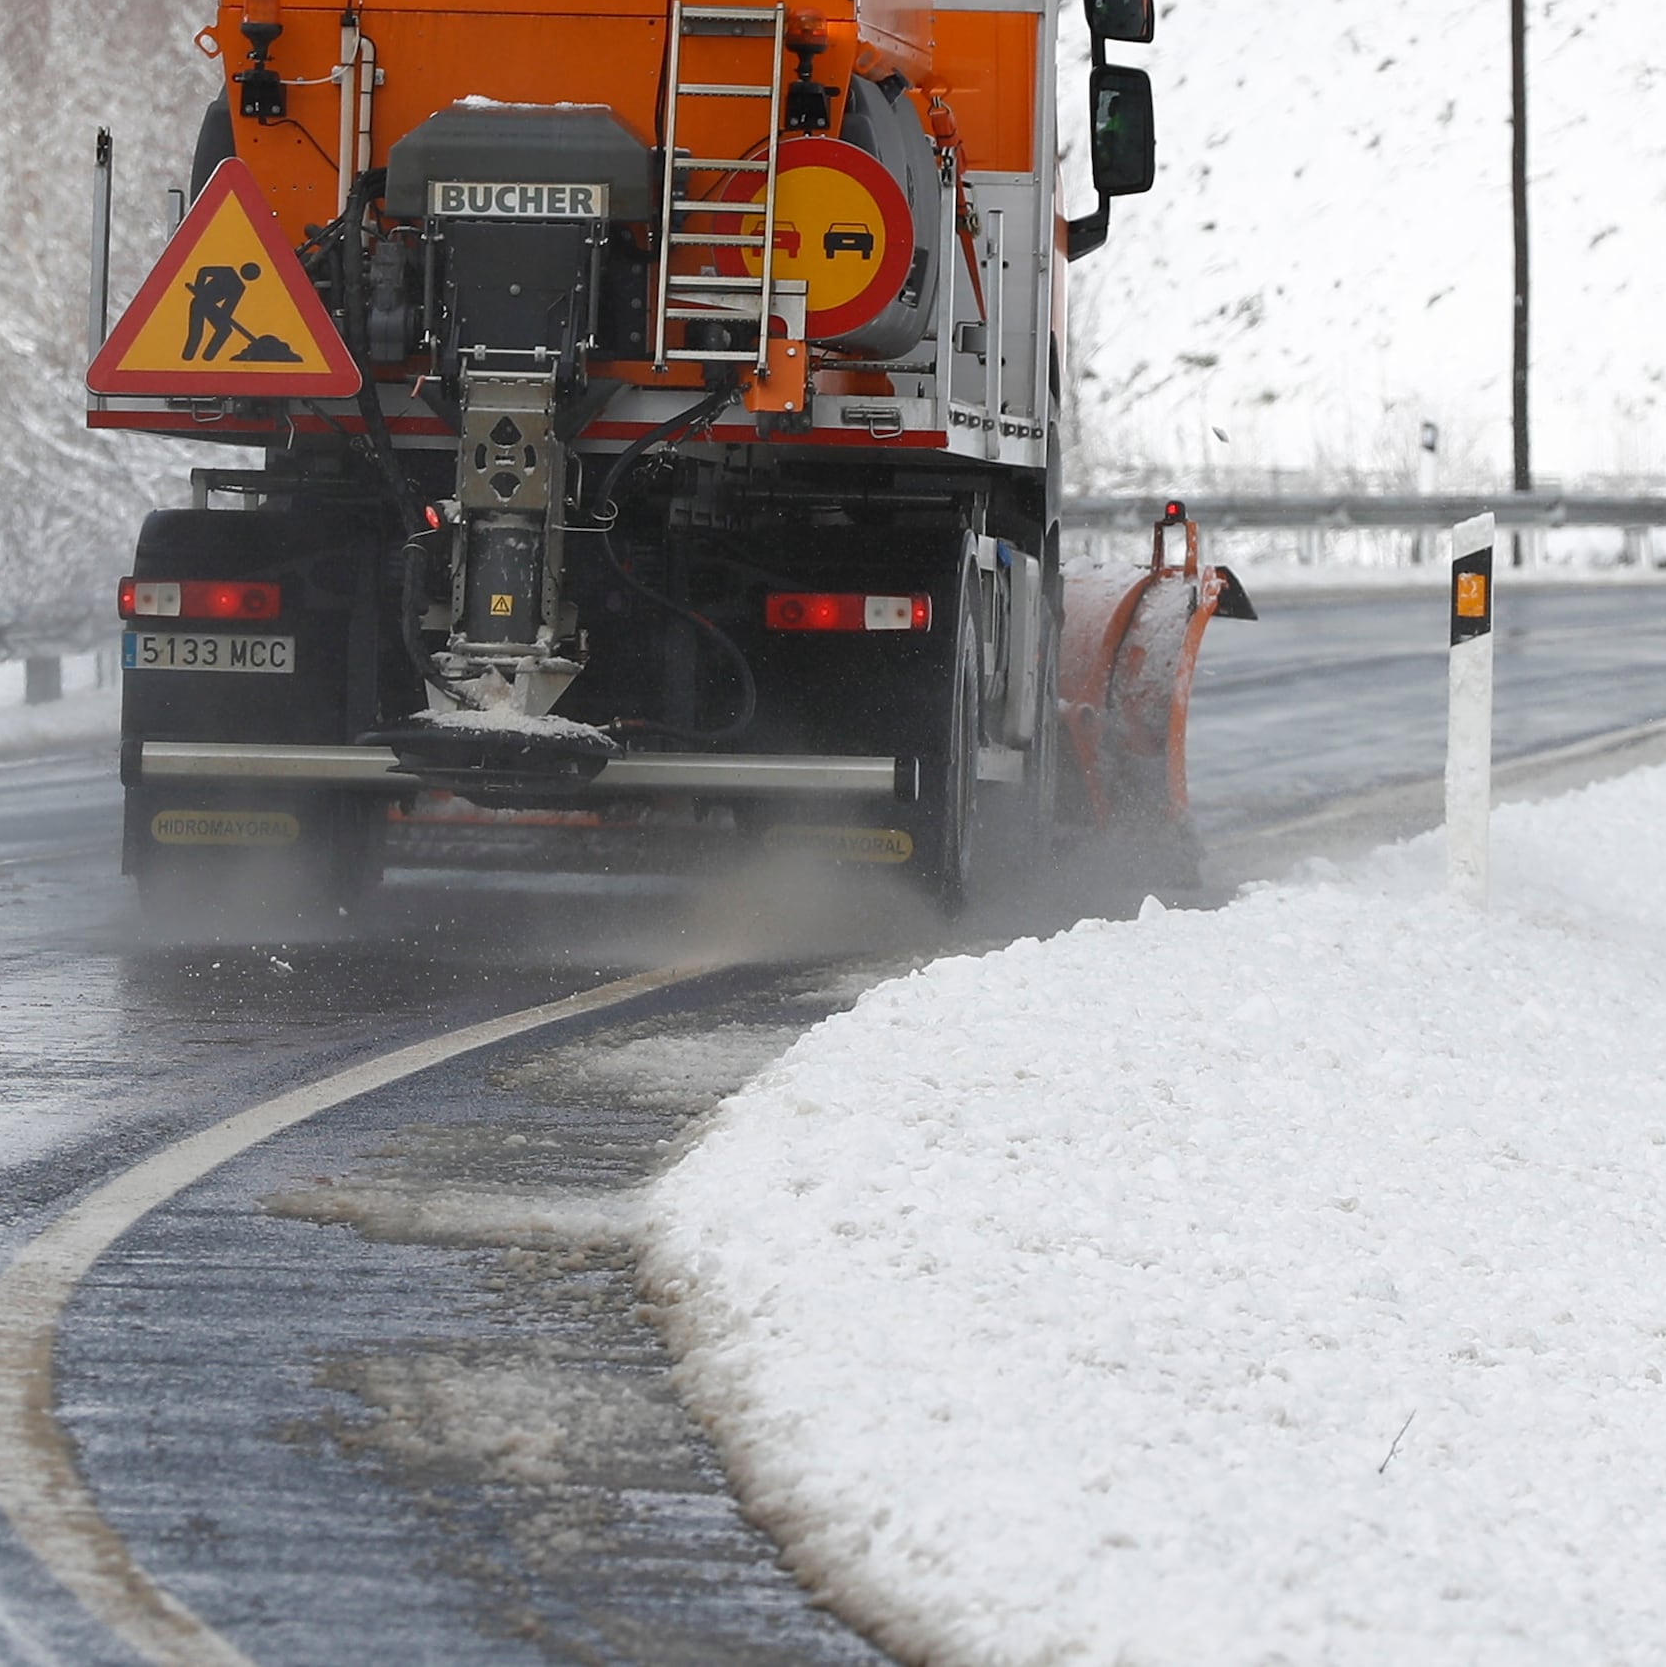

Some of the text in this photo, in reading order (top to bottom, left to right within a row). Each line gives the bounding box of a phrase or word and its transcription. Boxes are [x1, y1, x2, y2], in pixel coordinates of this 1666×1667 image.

[441, 185, 594, 214] BUCHER
[142, 636, 286, 668] 5133 MCC
[157, 819, 293, 837] HIDROMAYORAL
